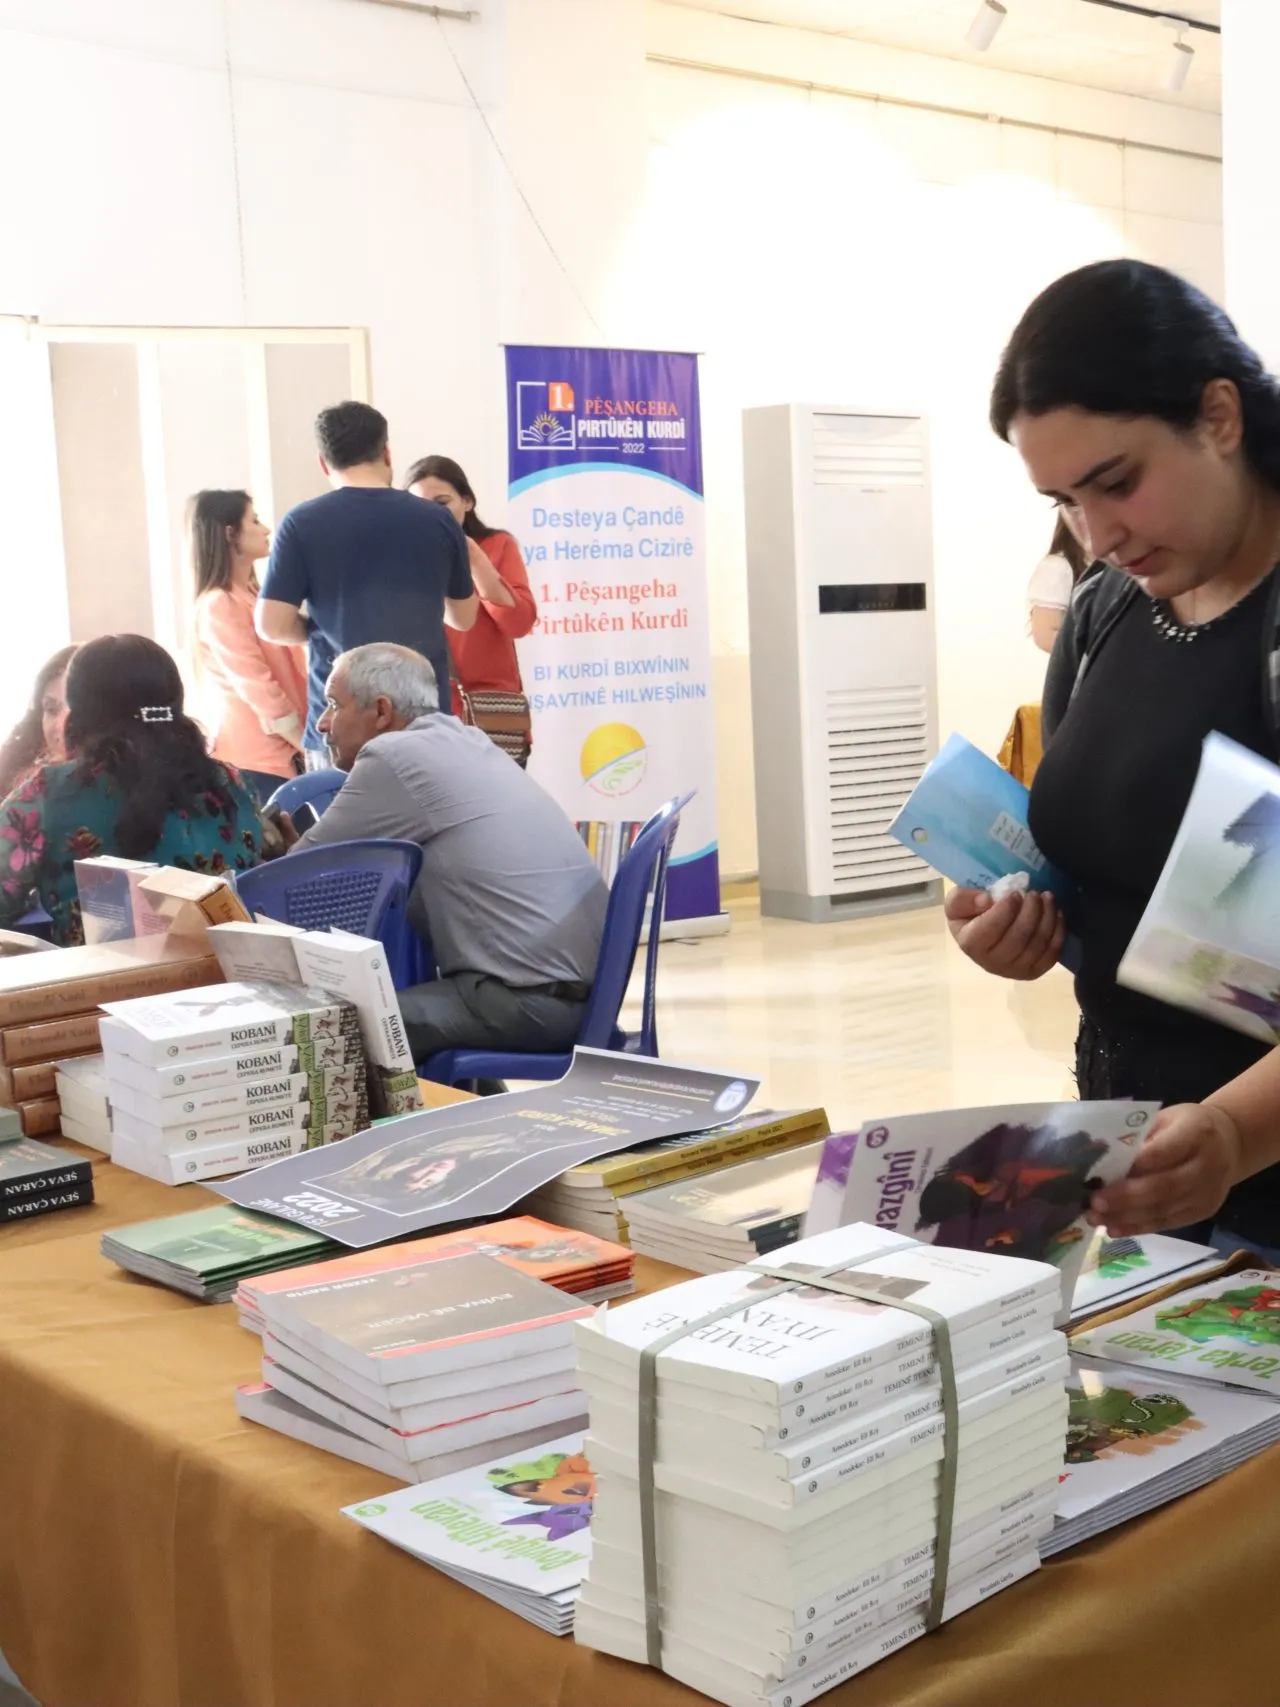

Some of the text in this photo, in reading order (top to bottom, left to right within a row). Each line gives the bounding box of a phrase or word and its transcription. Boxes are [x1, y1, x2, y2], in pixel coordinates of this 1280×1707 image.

[552, 386, 574, 409] 1.
[585, 396, 679, 417] PÊŞANGEHA
[577, 418, 686, 439] PIRTÛKÊN KURDÎ
[622, 443, 645, 454] 2022
[532, 506, 684, 532] Desteya Çandê
[524, 538, 694, 566] ya Herêma Cizîrê
[541, 579, 678, 605] 1. Pêşangeha
[631, 608, 689, 630] Kurdî
[534, 655, 690, 681] BI KURDÎ BIXWÎNIN
[529, 682, 707, 713] IŞAVTINÊ HILWEŞÎNIN
[230, 1022, 277, 1042] KOBANÎ
[388, 1014, 409, 1058] KOBANÎ
[236, 1051, 282, 1071] KOBANÎ
[246, 1078, 292, 1098] KOBANÎ
[248, 1106, 294, 1126] KOBANÎ
[247, 1136, 292, 1156] KOBANÎ
[282, 1191, 360, 1218] 2022
[643, 1312, 792, 1360] TEMEÊ
